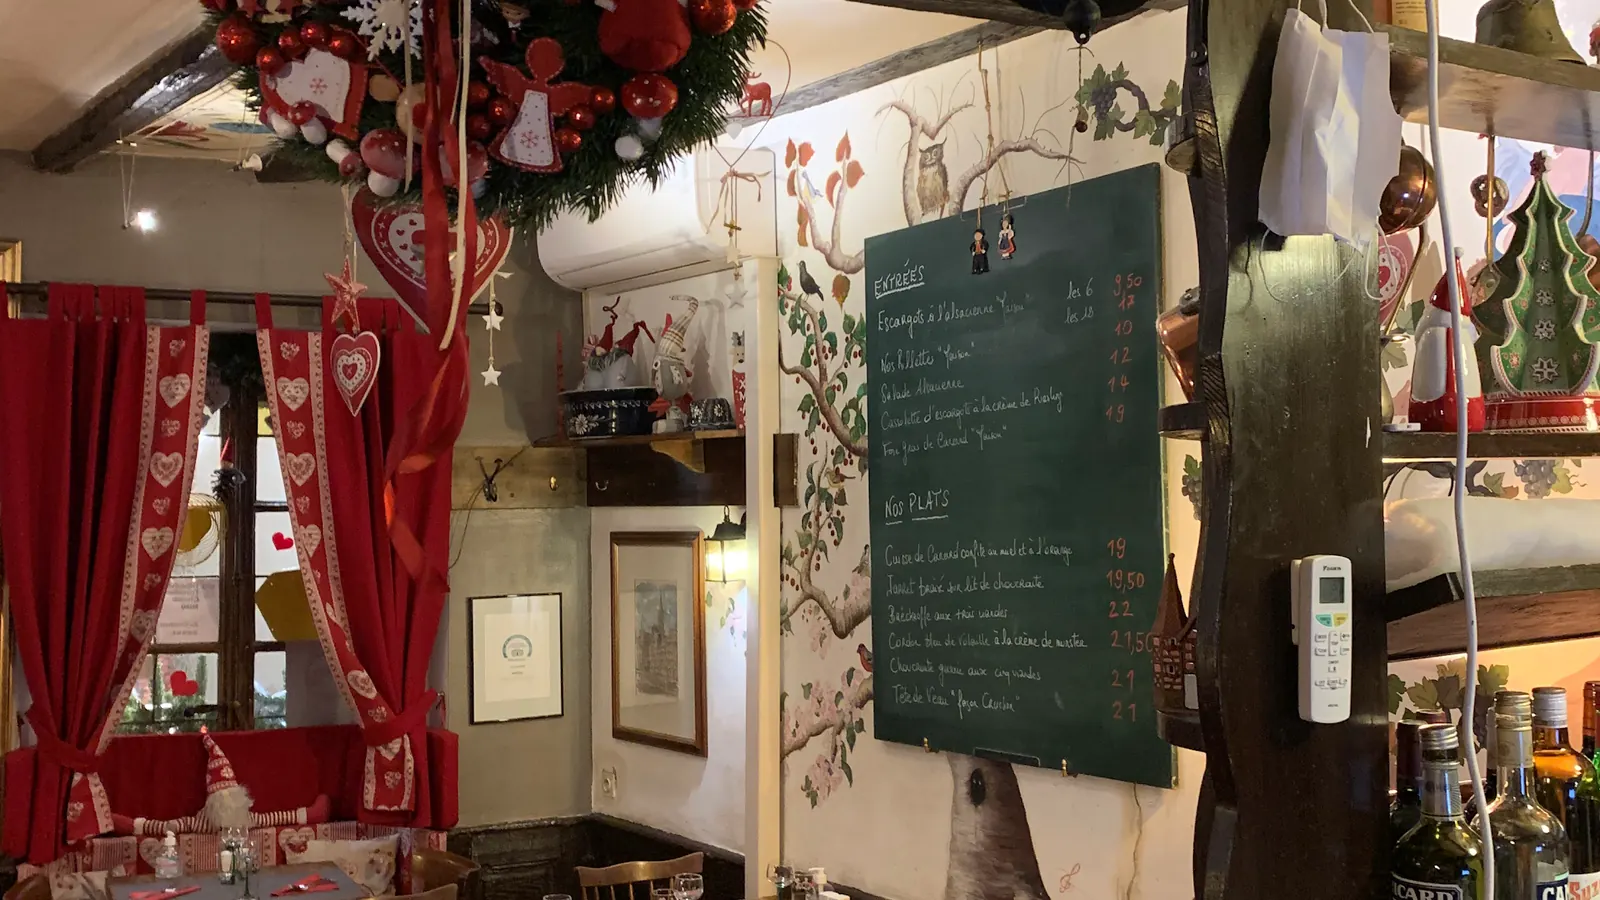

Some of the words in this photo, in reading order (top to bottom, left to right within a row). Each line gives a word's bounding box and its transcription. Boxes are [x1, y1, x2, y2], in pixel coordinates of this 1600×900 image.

[874, 259, 925, 297] ENTRÉES
[877, 309, 924, 339] Escargots
[937, 301, 994, 323] l'alsacienne
[1065, 280, 1081, 300] les
[1085, 277, 1095, 297] 6
[1064, 306, 1079, 324] les
[1081, 305, 1095, 321] 18
[1118, 294, 1136, 312] 17
[880, 352, 896, 374] Nos
[1114, 319, 1133, 336] 10
[880, 382, 912, 404] Salade
[1109, 346, 1133, 365] 12
[880, 408, 922, 431] Cassolette
[973, 398, 980, 413] à
[981, 395, 992, 413] la
[992, 396, 1018, 412] crème
[1019, 391, 1031, 408] de
[1033, 386, 1063, 414] Riesling
[1107, 373, 1130, 394] 14
[902, 440, 920, 466] gras
[923, 433, 934, 451] de
[936, 428, 969, 449] Canard
[1105, 404, 1126, 424] 19
[884, 495, 904, 518] Nos
[908, 488, 950, 513] PLATS
[884, 544, 913, 567] Cuisse
[914, 543, 925, 563] de
[927, 540, 960, 563] Canard
[987, 547, 998, 557] au
[999, 538, 1017, 557] miel
[1018, 542, 1027, 557] et
[1028, 537, 1035, 556] à
[1037, 536, 1073, 567] l'orange
[1106, 537, 1127, 560] 19
[886, 573, 916, 597] Jarret
[918, 573, 945, 597] braisé
[946, 580, 963, 593] sur
[963, 575, 978, 593] lit
[979, 571, 990, 591] de
[993, 571, 1045, 590] choucroute
[1106, 569, 1146, 595] 19,50
[933, 611, 952, 622] aux
[954, 605, 975, 621] trois
[978, 603, 1009, 619] viandes
[1108, 600, 1134, 619] 22
[888, 632, 921, 650] Cordon
[944, 633, 956, 648] de
[993, 629, 1000, 646] à
[1001, 628, 1013, 646] la
[1014, 631, 1040, 648] crème
[1041, 630, 1053, 648] de
[1055, 632, 1088, 649] munster
[1110, 630, 1154, 656] 21,50
[889, 656, 934, 674] Choucroute
[967, 667, 987, 677] aux
[994, 666, 1011, 687] cinq
[1011, 665, 1041, 681] viandes
[1111, 669, 1135, 693] 21
[892, 683, 912, 705] Tête
[912, 684, 923, 704] de
[926, 686, 949, 706] Veau
[1112, 700, 1137, 723] 21
[1542, 884, 1568, 900] CA
[1569, 880, 1600, 900] Suz
